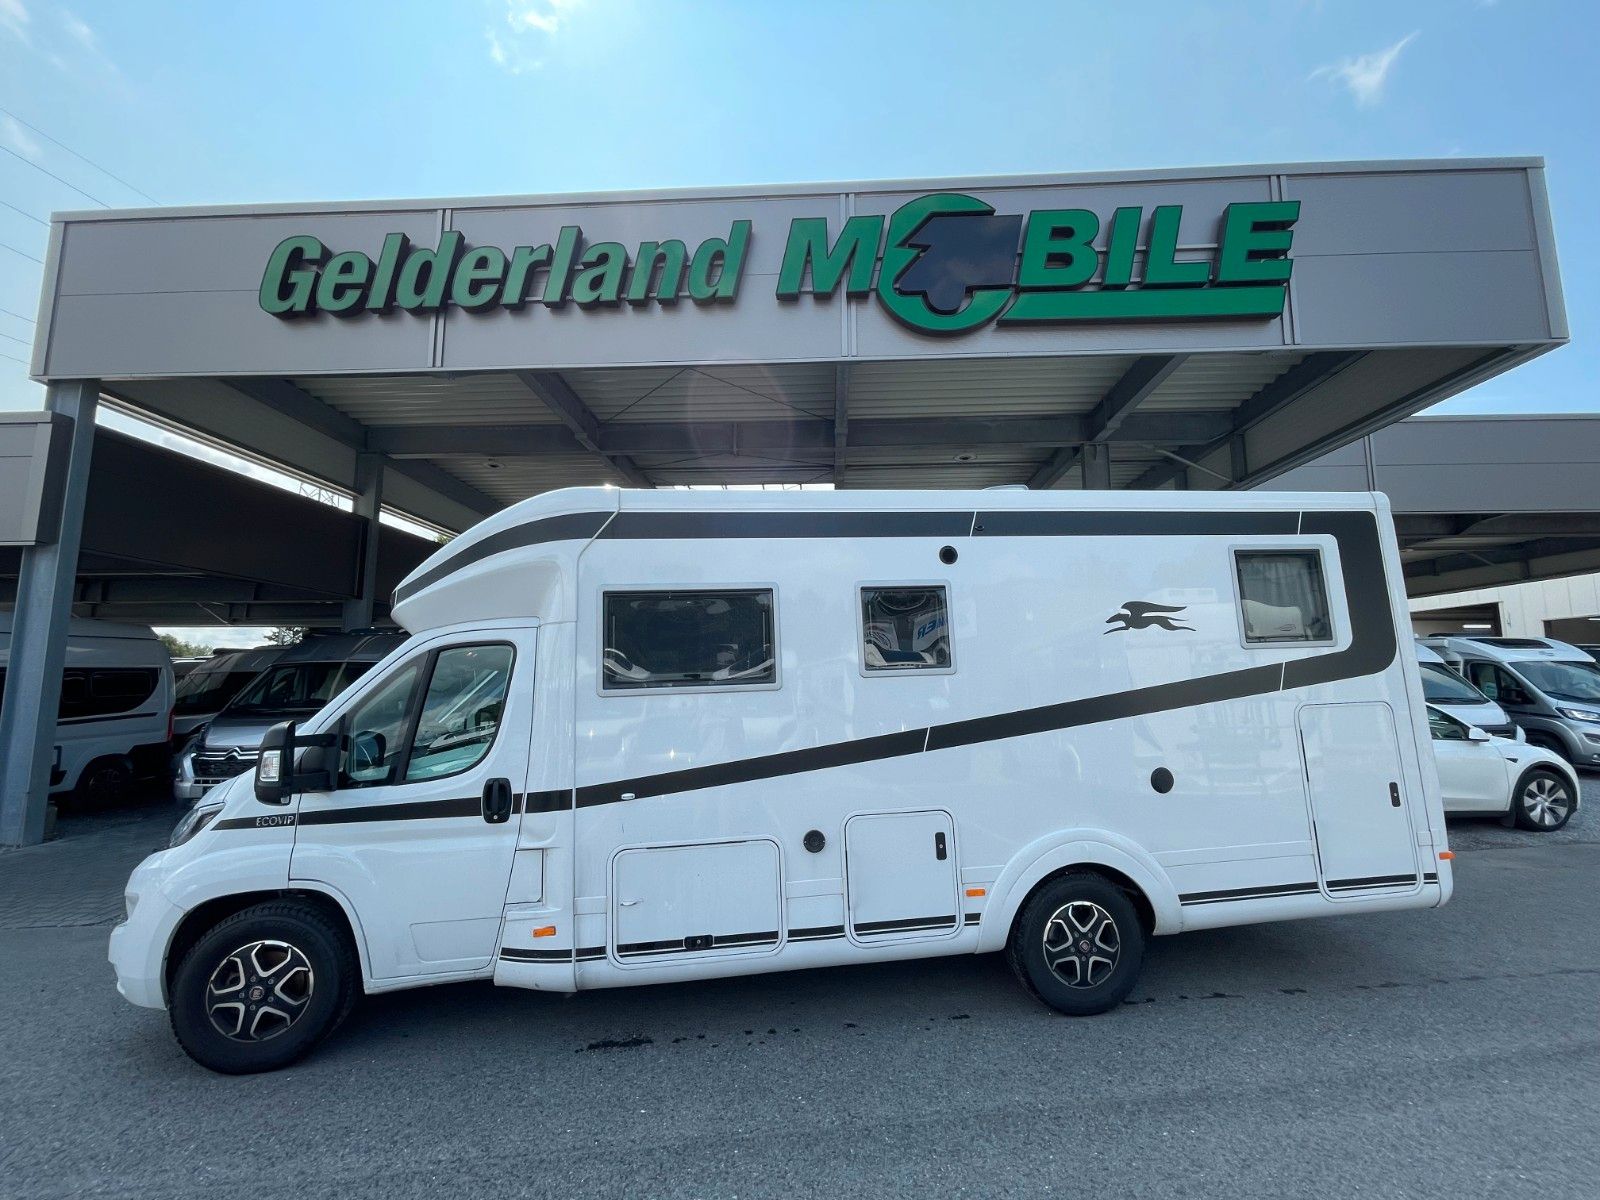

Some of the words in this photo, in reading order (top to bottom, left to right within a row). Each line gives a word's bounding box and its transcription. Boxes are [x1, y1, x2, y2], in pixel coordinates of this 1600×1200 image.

[258, 219, 752, 317] Gelderland
[776, 193, 1301, 335] MOBILE
[256, 815, 294, 827] ECOVIP
